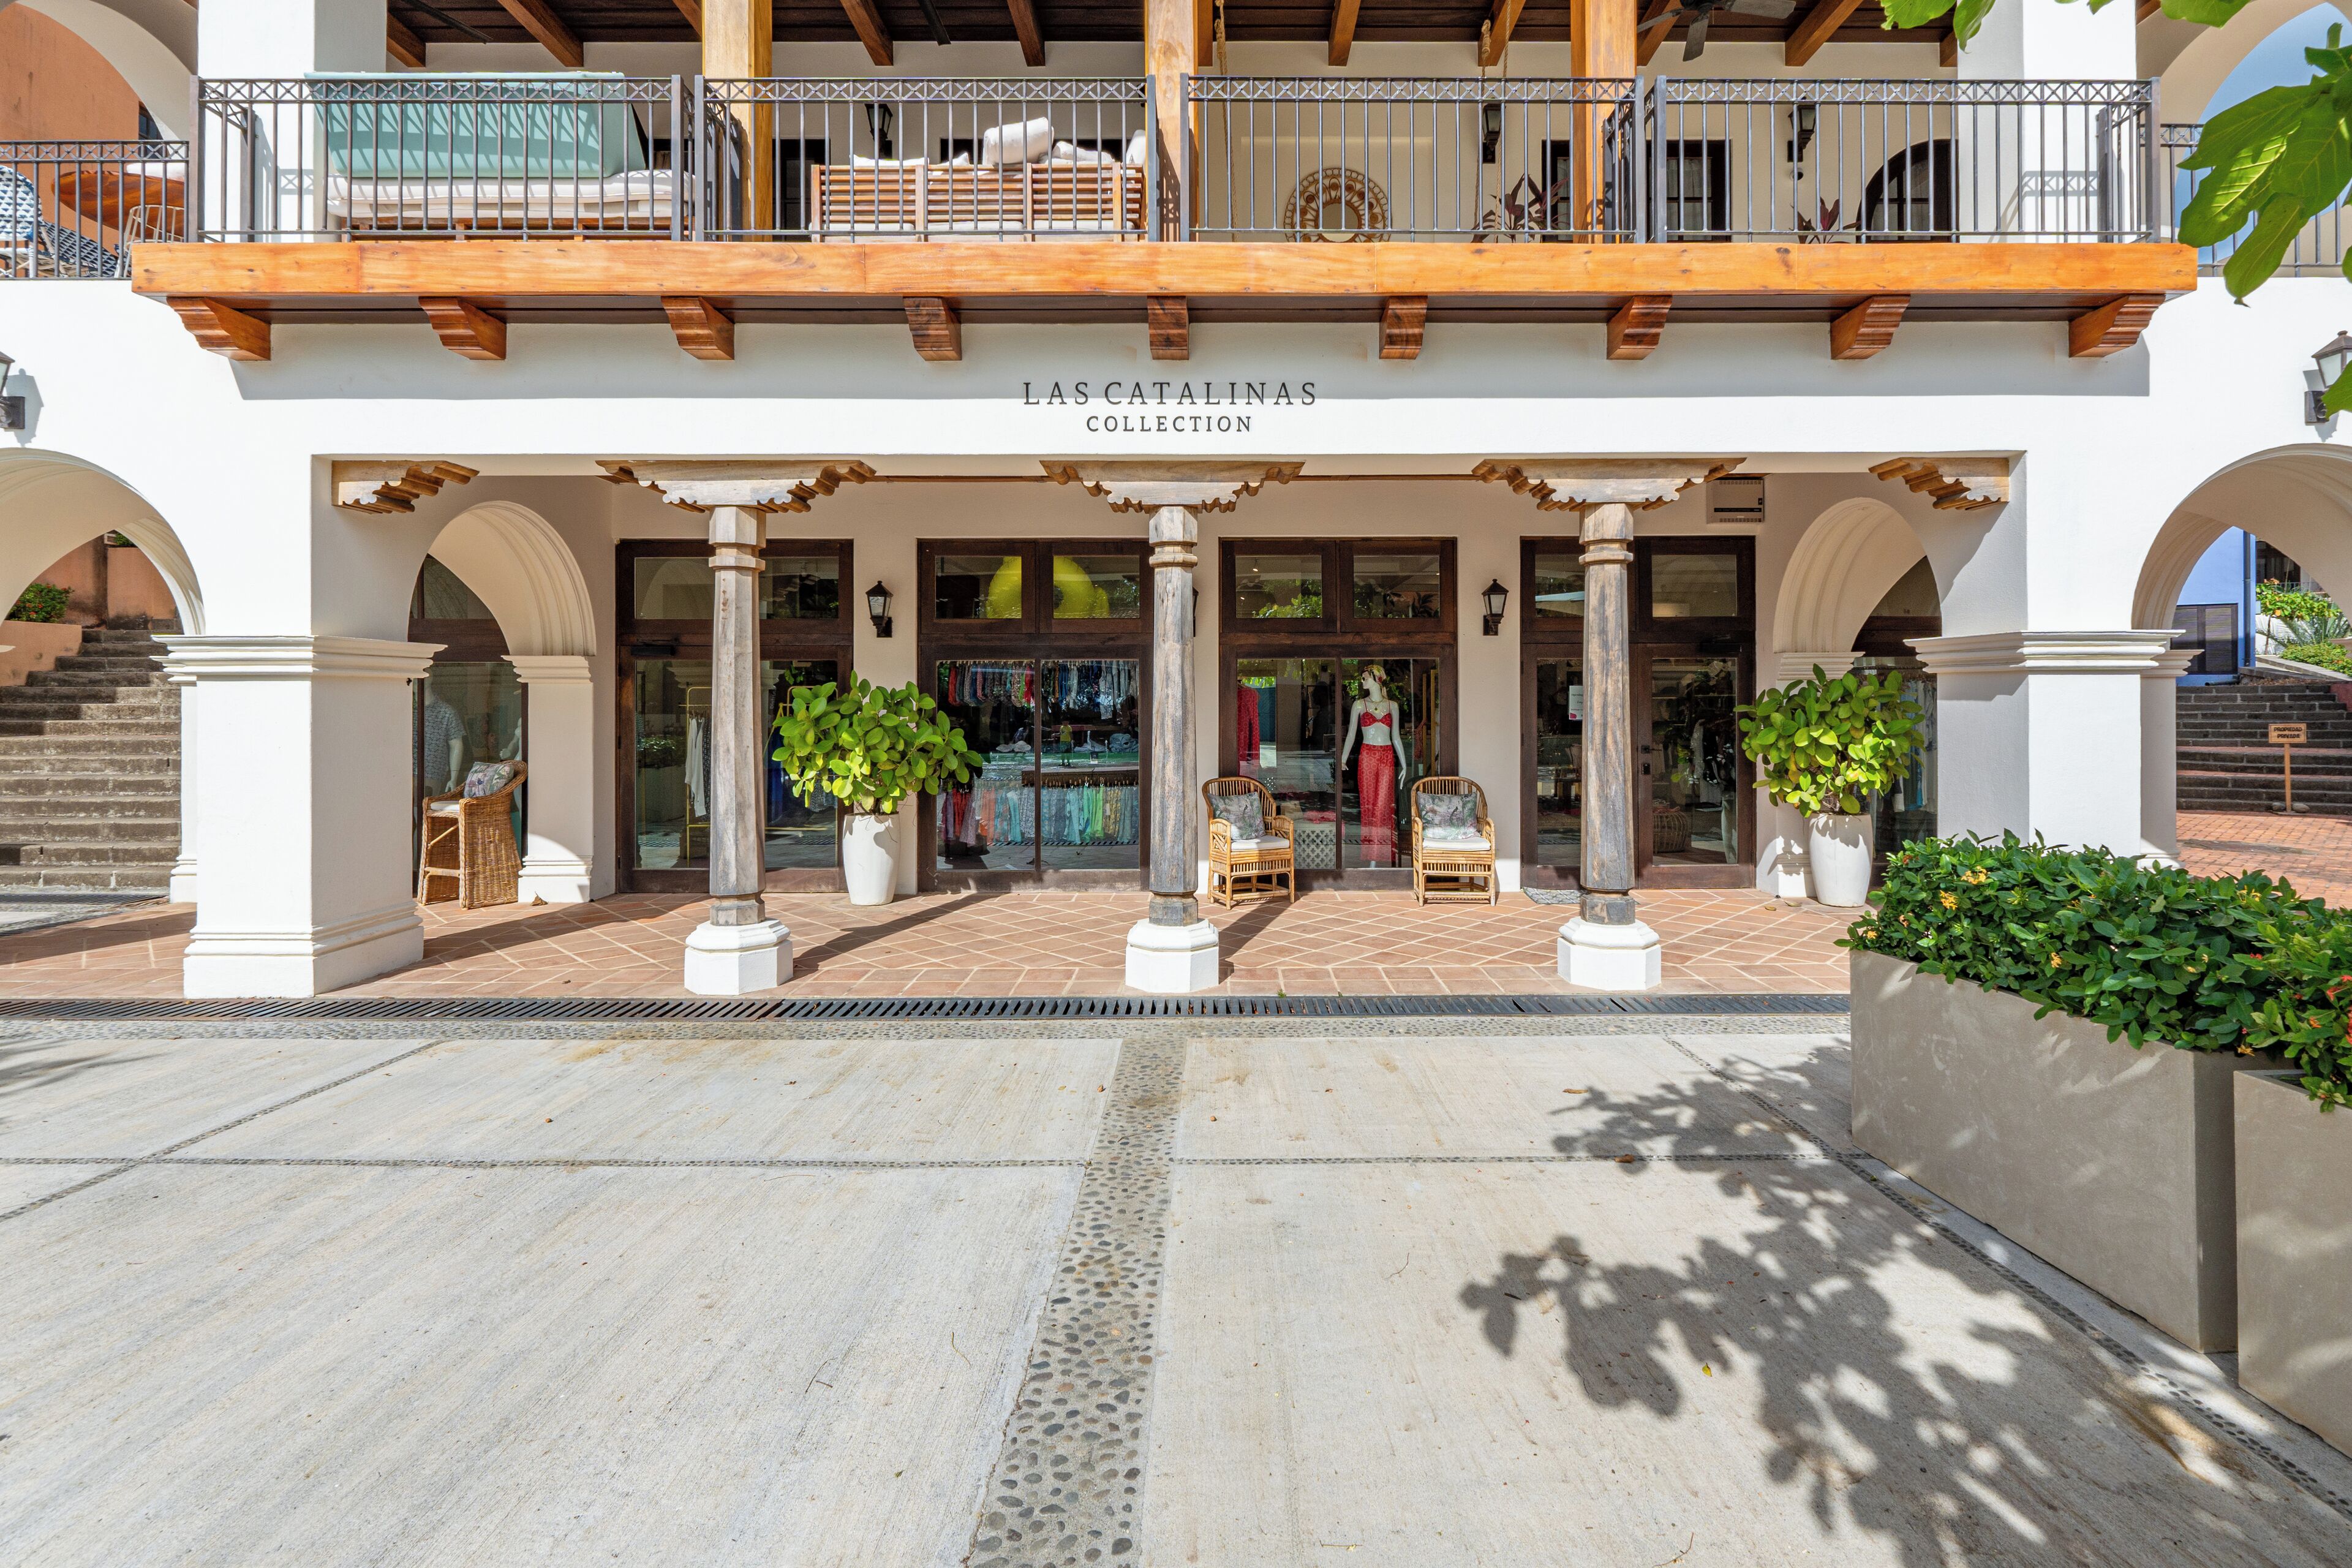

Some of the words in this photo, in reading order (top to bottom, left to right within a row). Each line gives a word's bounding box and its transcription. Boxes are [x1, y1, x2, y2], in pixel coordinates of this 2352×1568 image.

[1023, 382, 1089, 405] LAS
[1104, 382, 1316, 405] CATALINAS
[1086, 415, 1251, 432] COLLECTION
